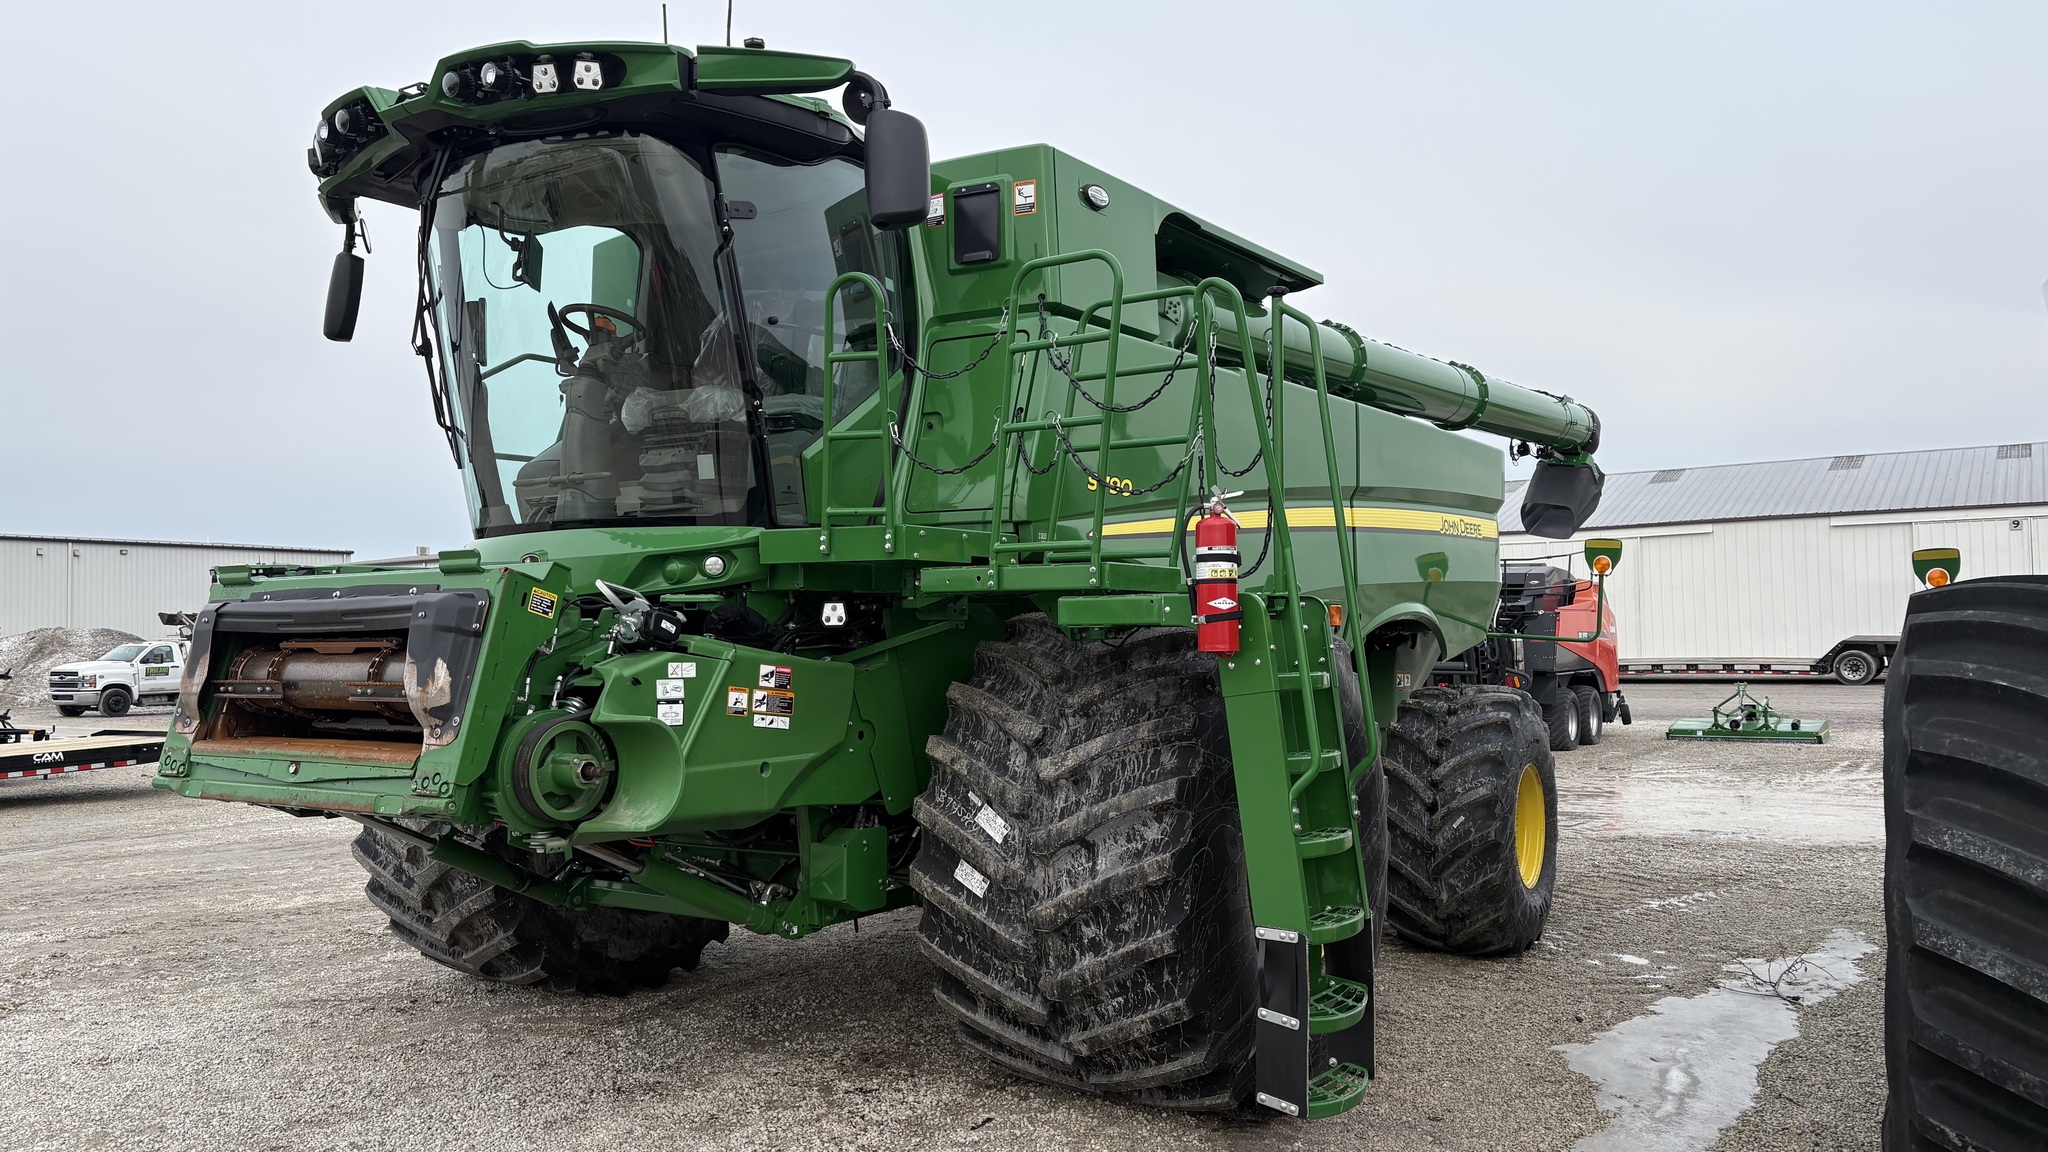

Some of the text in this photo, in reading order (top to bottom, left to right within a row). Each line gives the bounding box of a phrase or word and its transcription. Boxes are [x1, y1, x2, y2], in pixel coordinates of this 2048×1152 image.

[1087, 472, 1133, 497] S90
[1440, 515, 1483, 537] JOHN DEERE
[2012, 519, 2020, 529] 9
[536, 590, 557, 601] CAUTION
[33, 751, 65, 762] CAM
